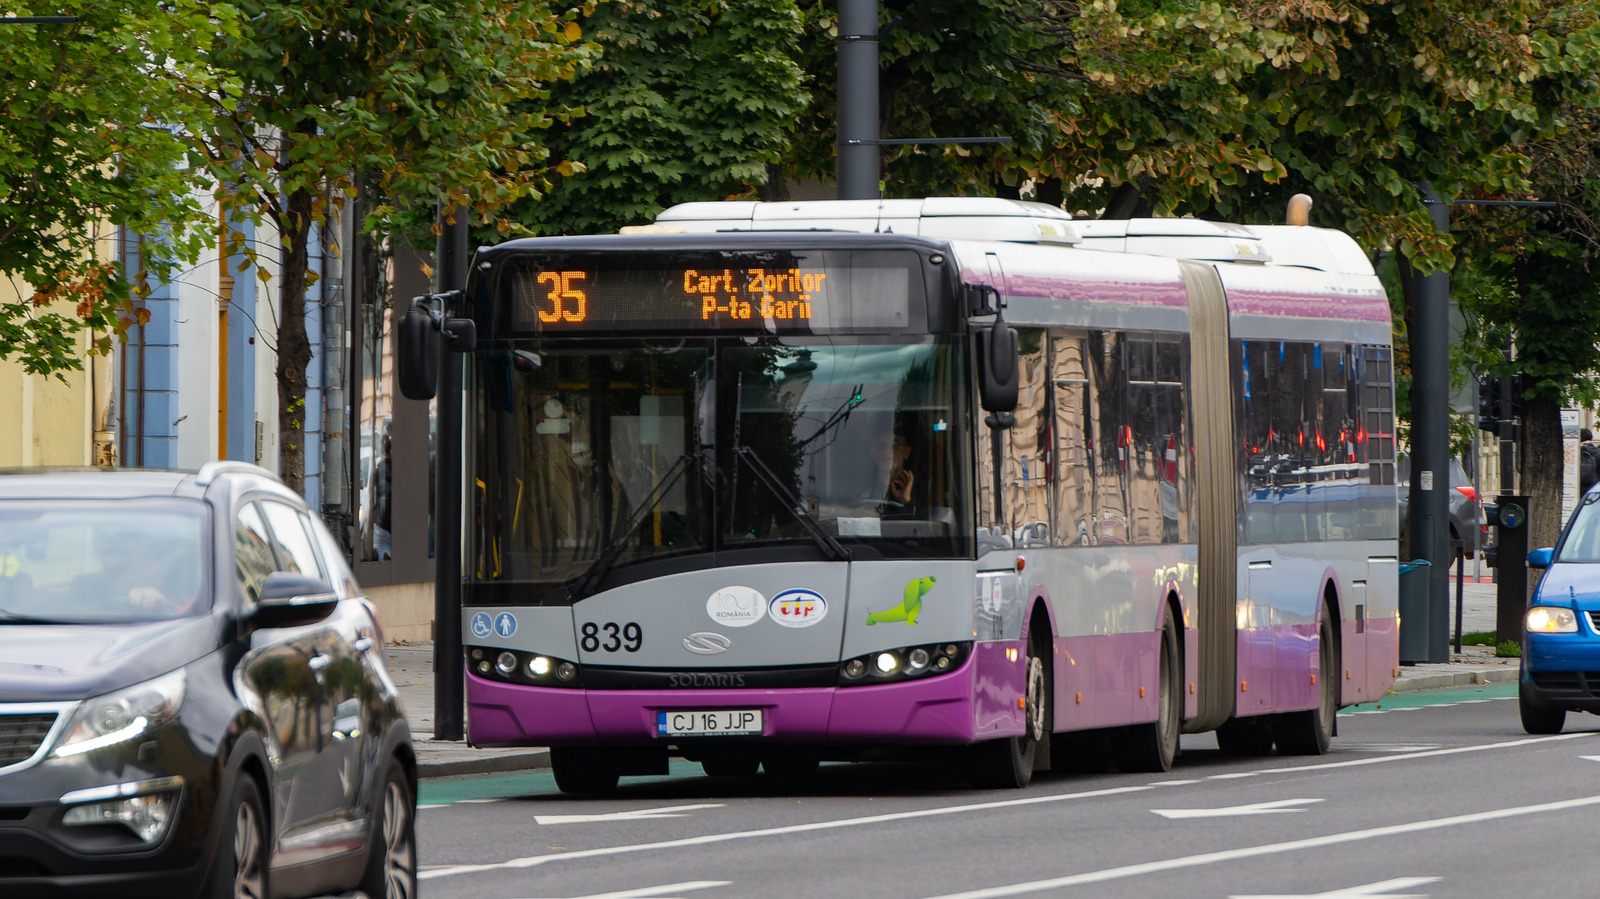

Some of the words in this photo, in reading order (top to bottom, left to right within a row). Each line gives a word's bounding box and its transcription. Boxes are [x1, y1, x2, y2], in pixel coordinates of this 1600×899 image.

[683, 269, 738, 293] Cart.
[748, 268, 826, 293] Zorilor
[537, 271, 586, 322] 35
[702, 295, 750, 320] P-ta
[760, 294, 811, 319] Garii
[580, 622, 643, 652] 839
[670, 672, 745, 687] SOLARIS
[673, 714, 694, 731] CJ
[701, 713, 717, 730] 16
[724, 712, 755, 729] JJP
